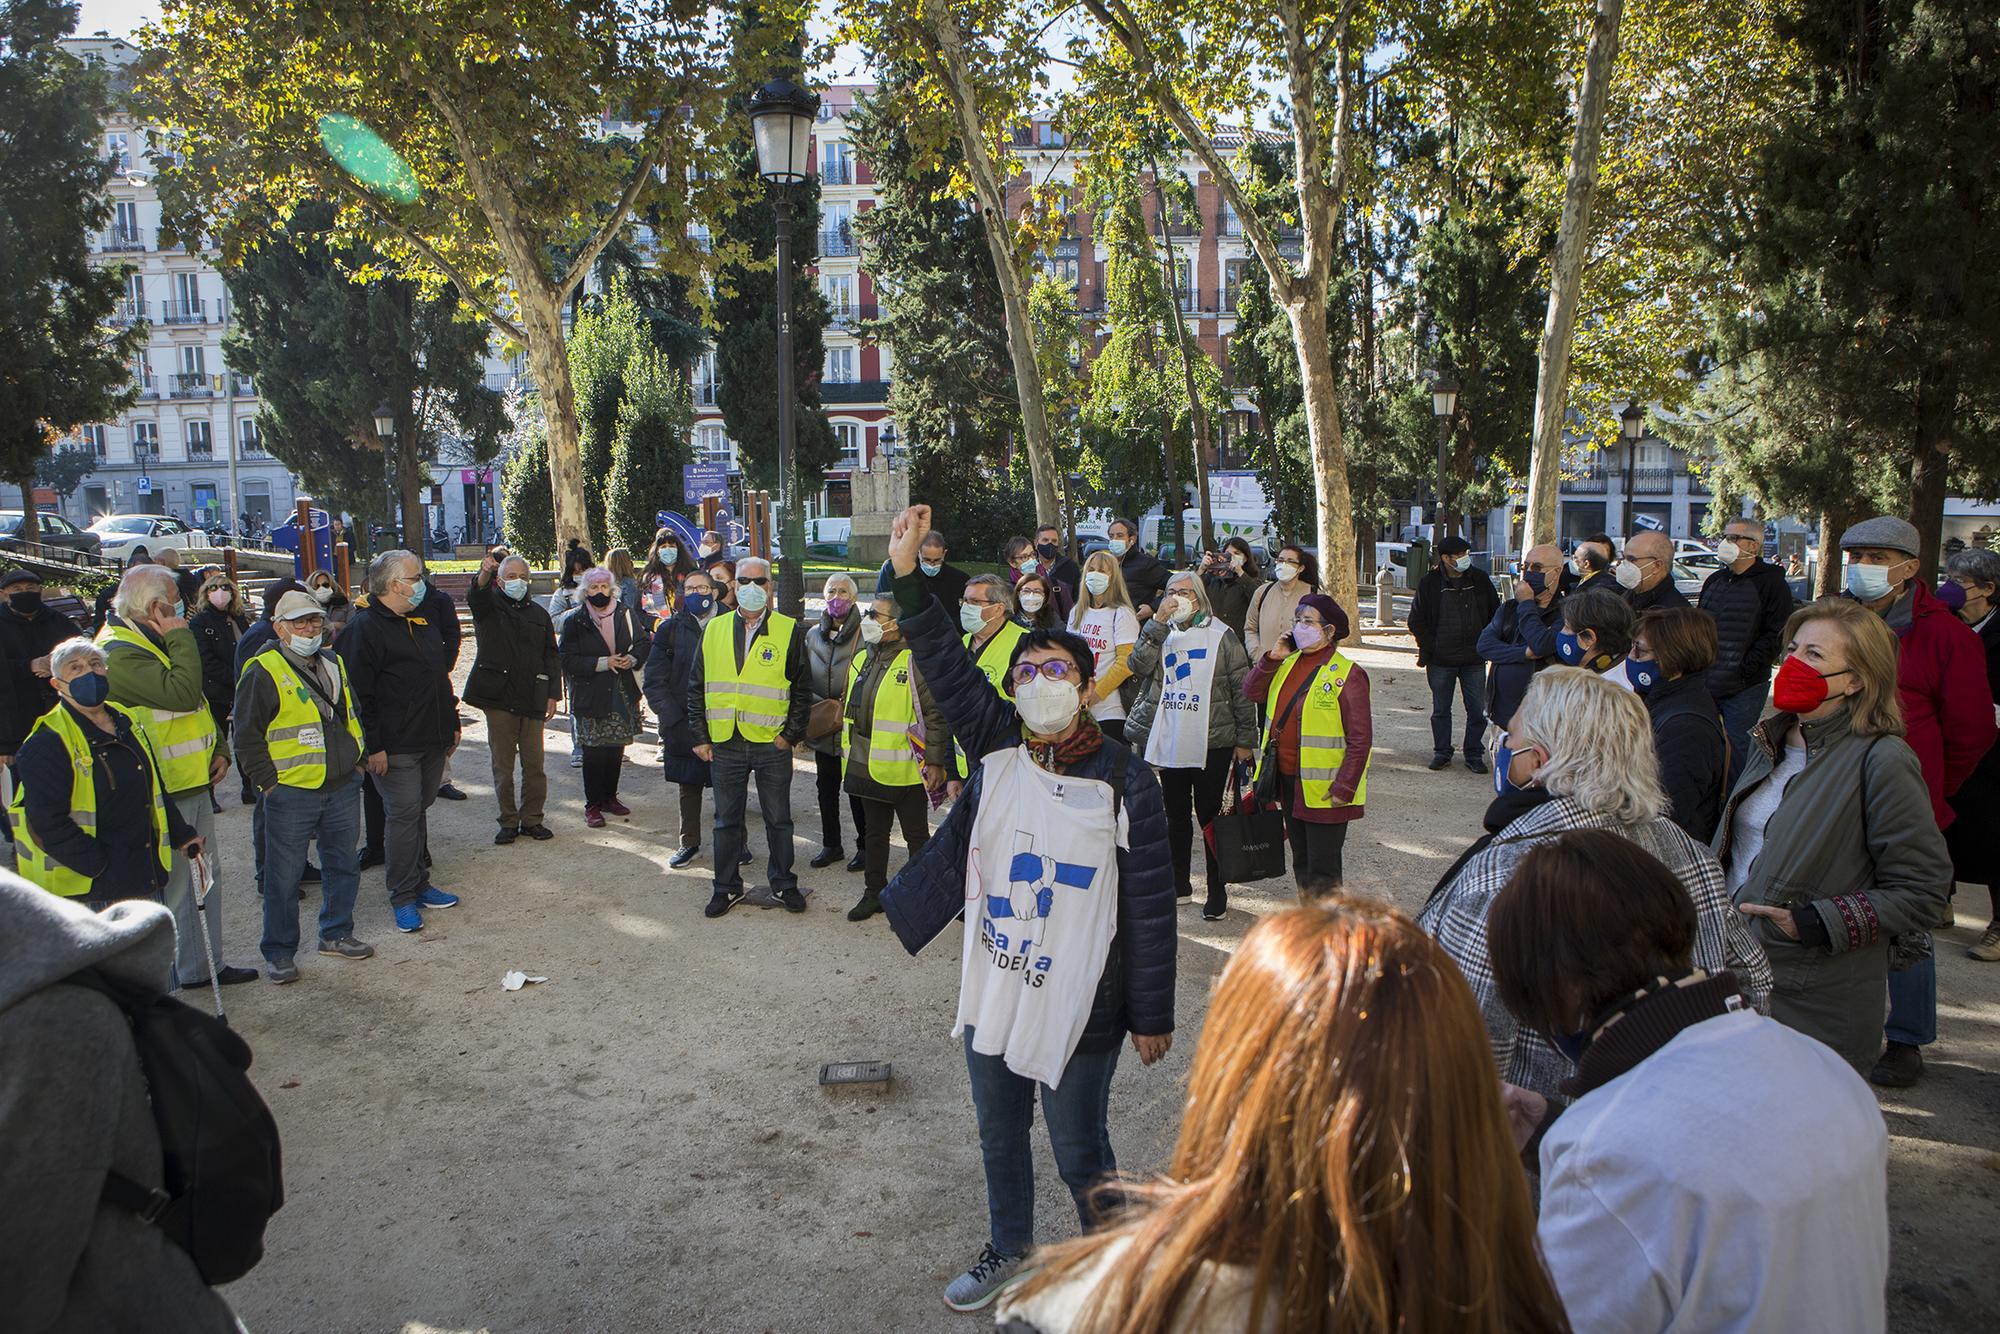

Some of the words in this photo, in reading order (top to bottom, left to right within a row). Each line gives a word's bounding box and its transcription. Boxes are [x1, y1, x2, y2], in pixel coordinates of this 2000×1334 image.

[139, 478, 147, 489] P
[1082, 623, 1092, 634] LEY
[1092, 624, 1102, 636] DE
